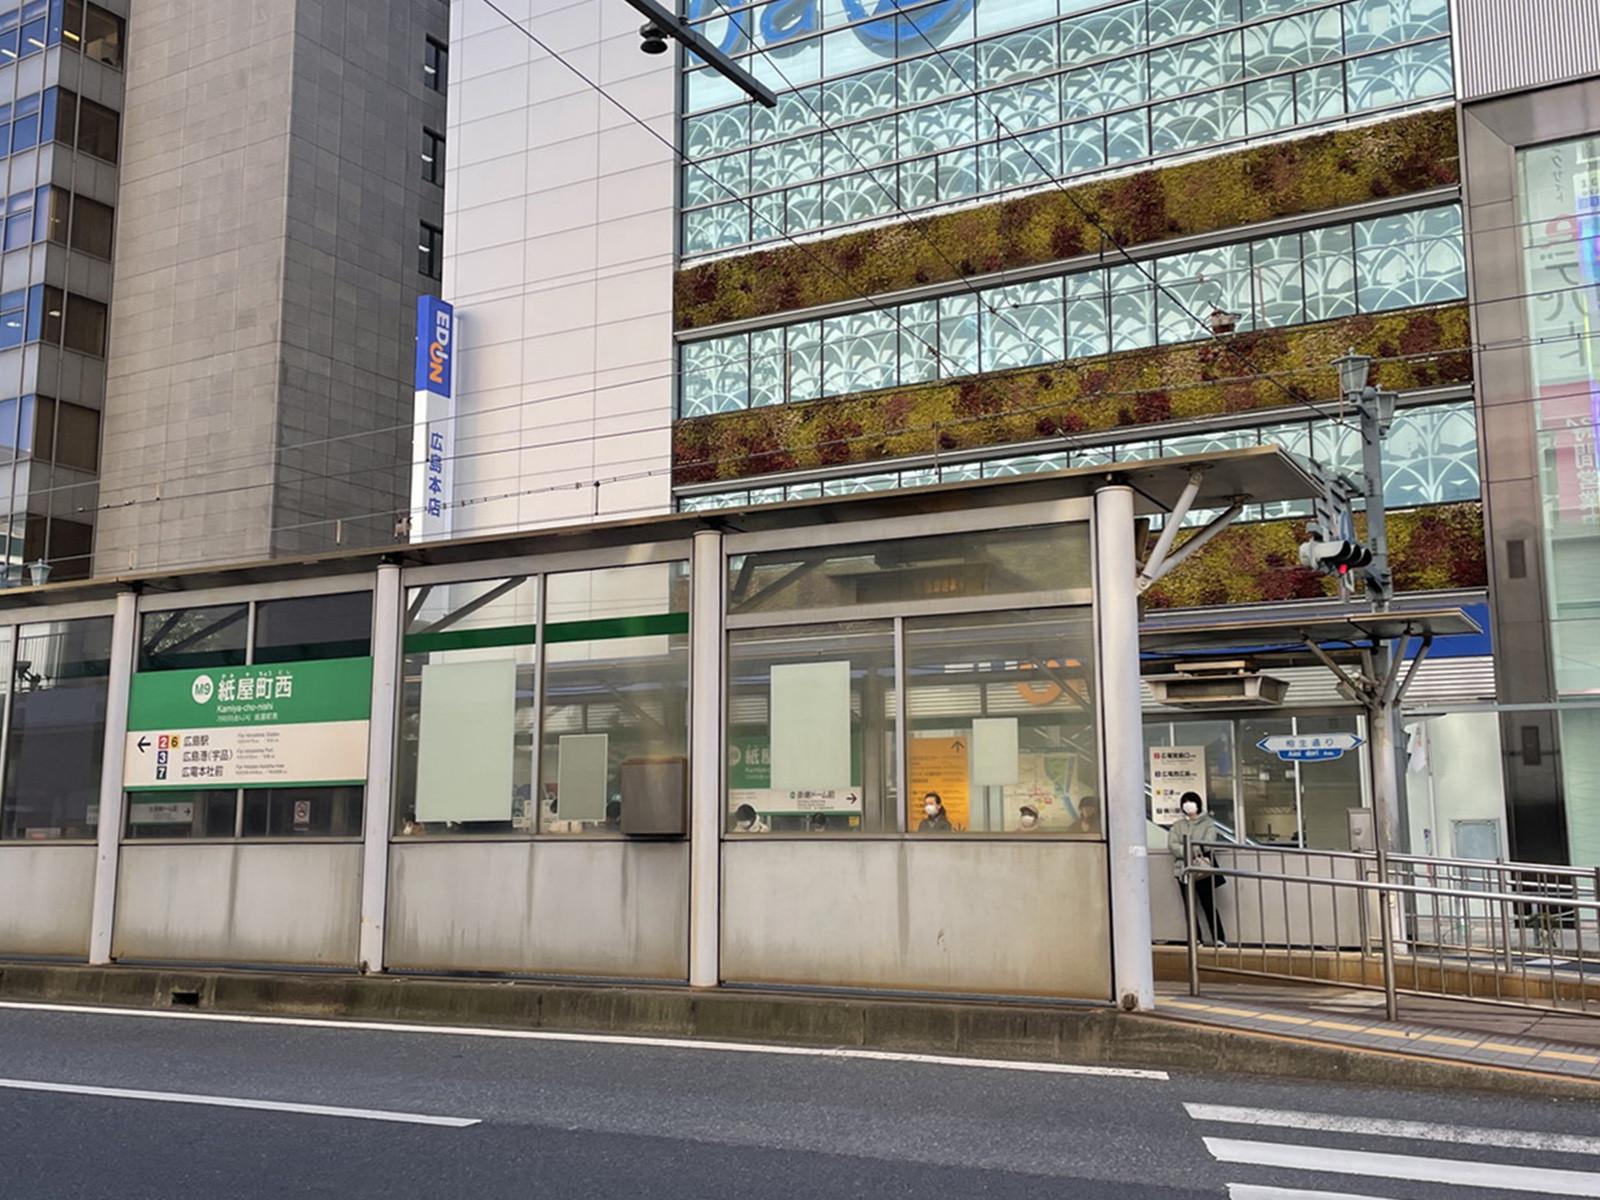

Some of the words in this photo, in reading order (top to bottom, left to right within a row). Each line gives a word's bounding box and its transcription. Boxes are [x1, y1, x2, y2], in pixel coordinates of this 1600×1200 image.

[427, 432, 444, 518] 広島本店
[194, 682, 212, 696] M9
[217, 675, 294, 702] 紙屋町西
[159, 736, 168, 748] 2
[170, 735, 179, 748] 6
[183, 735, 210, 747] 広島駅
[159, 751, 167, 764] 3
[158, 767, 165, 779] 7
